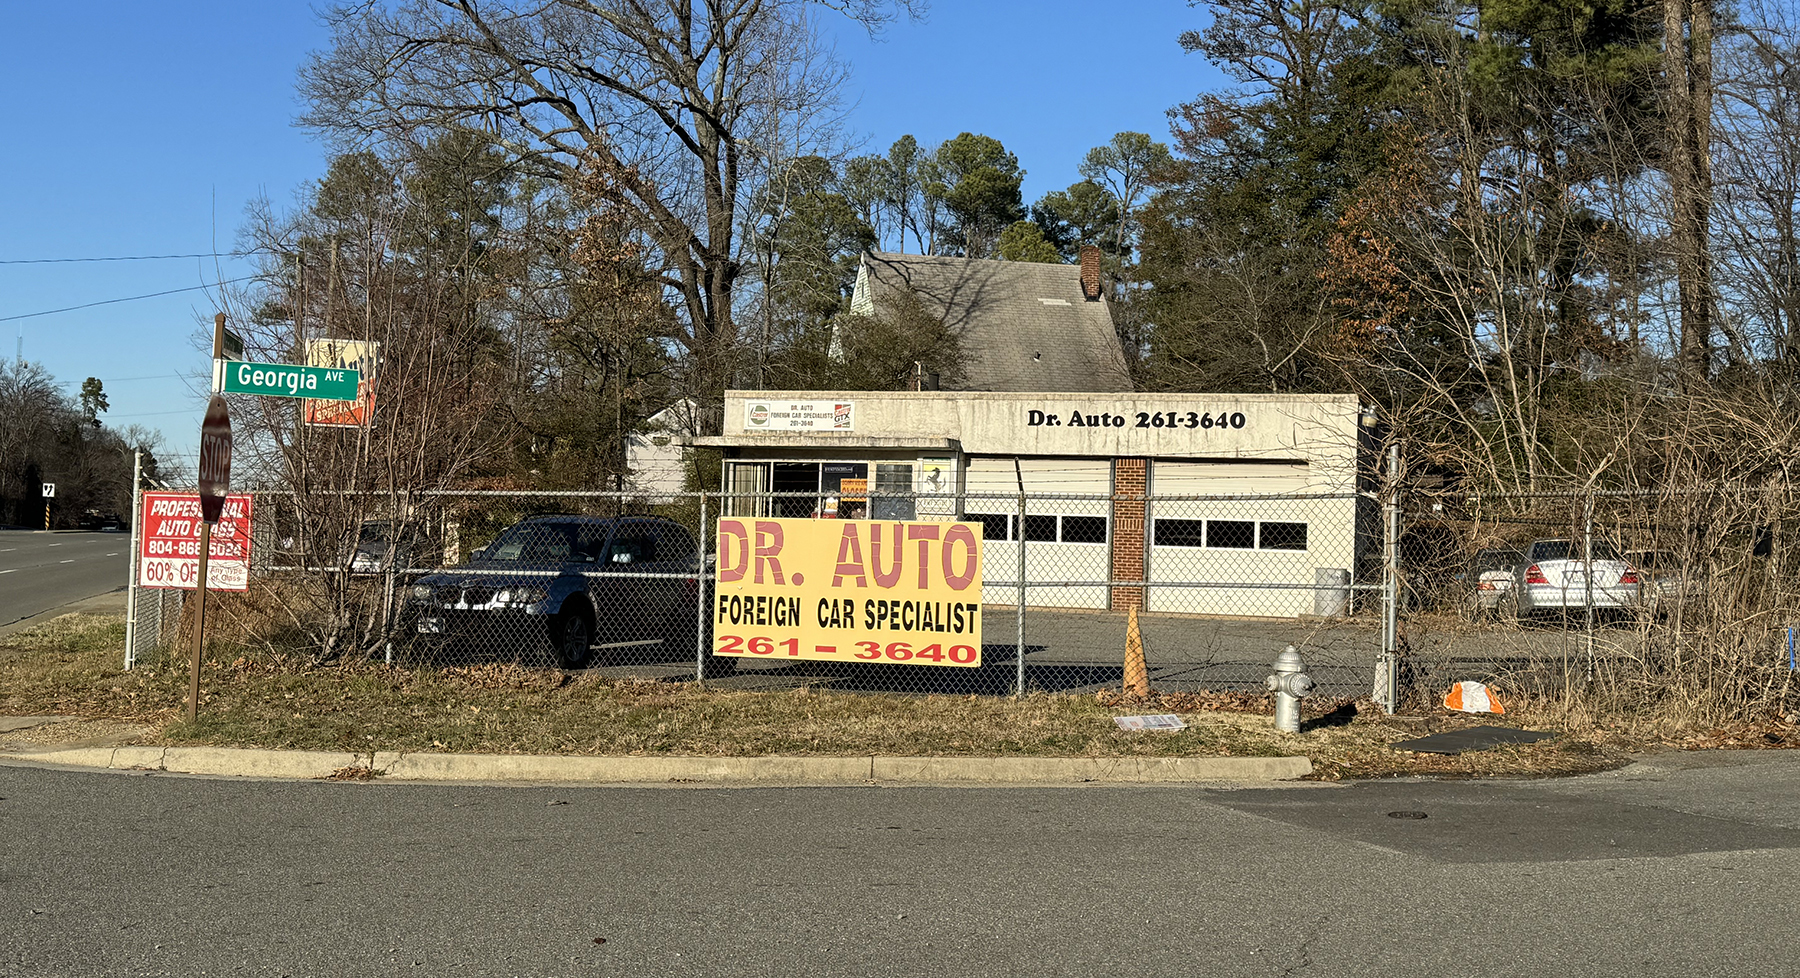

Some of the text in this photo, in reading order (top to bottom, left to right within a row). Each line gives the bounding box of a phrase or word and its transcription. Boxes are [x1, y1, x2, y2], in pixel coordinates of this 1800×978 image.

[237, 364, 317, 395] Georgia
[325, 371, 344, 382] AVE
[834, 412, 850, 423] GTX
[1028, 410, 1247, 429] Dr. Auto 261-3640
[201, 433, 230, 483] STOP
[150, 500, 244, 518] PROFESSNAL
[156, 519, 236, 538] AUTO GASS
[148, 540, 242, 557] 804-8685024
[719, 520, 978, 591] DR. AUTO
[146, 561, 198, 583] 60% OF
[718, 594, 978, 634] FOREIGN CAR SPECIALIST
[717, 635, 799, 656] 261
[854, 641, 978, 663] 3640
